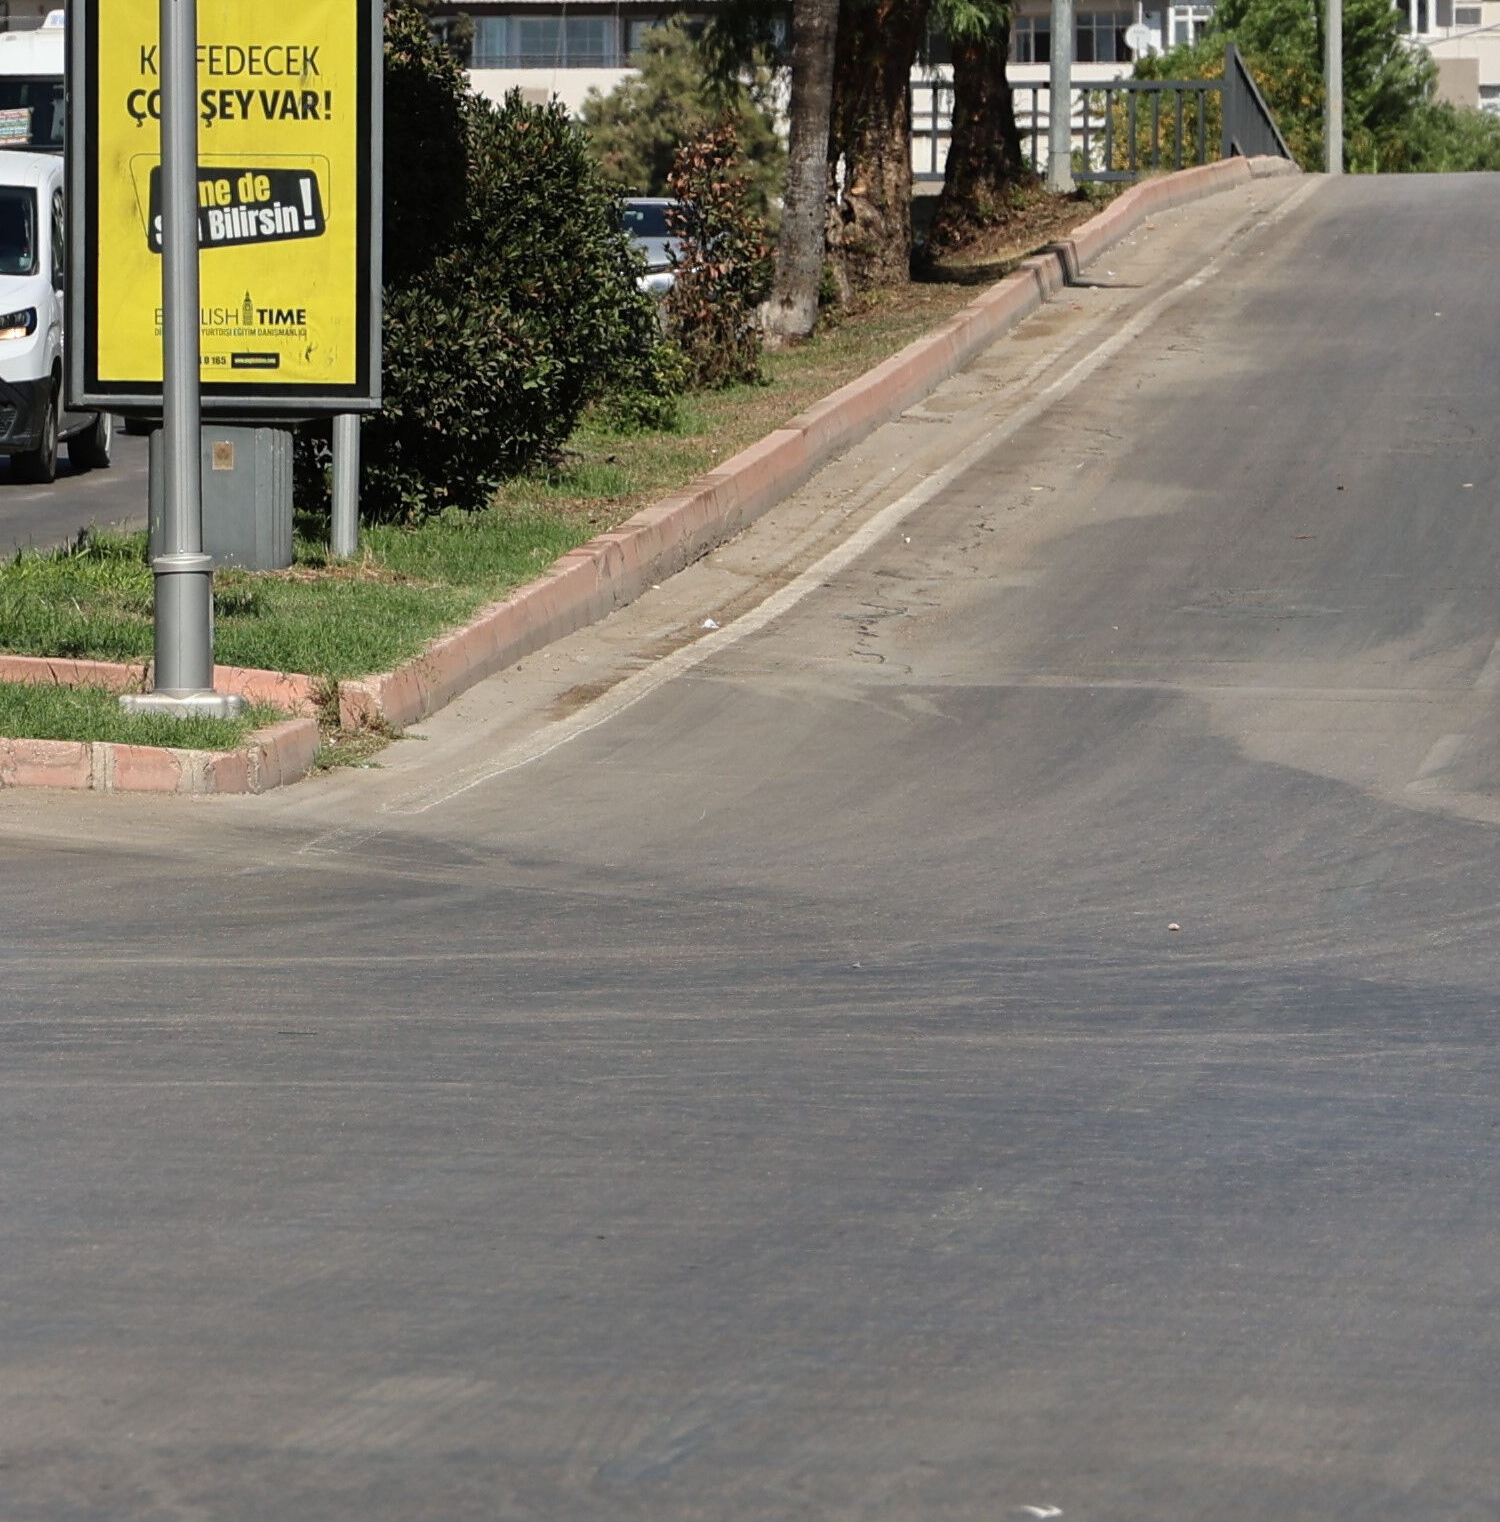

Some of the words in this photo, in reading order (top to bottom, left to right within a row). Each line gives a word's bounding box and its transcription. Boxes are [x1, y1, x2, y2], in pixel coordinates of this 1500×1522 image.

[141, 45, 320, 76] KFEDECEK
[200, 88, 255, 128] ŞEY
[259, 90, 332, 120] VAR!
[198, 178, 232, 207] ne
[237, 172, 271, 204] de
[154, 307, 239, 326] ELISH
[256, 308, 306, 326] TIME
